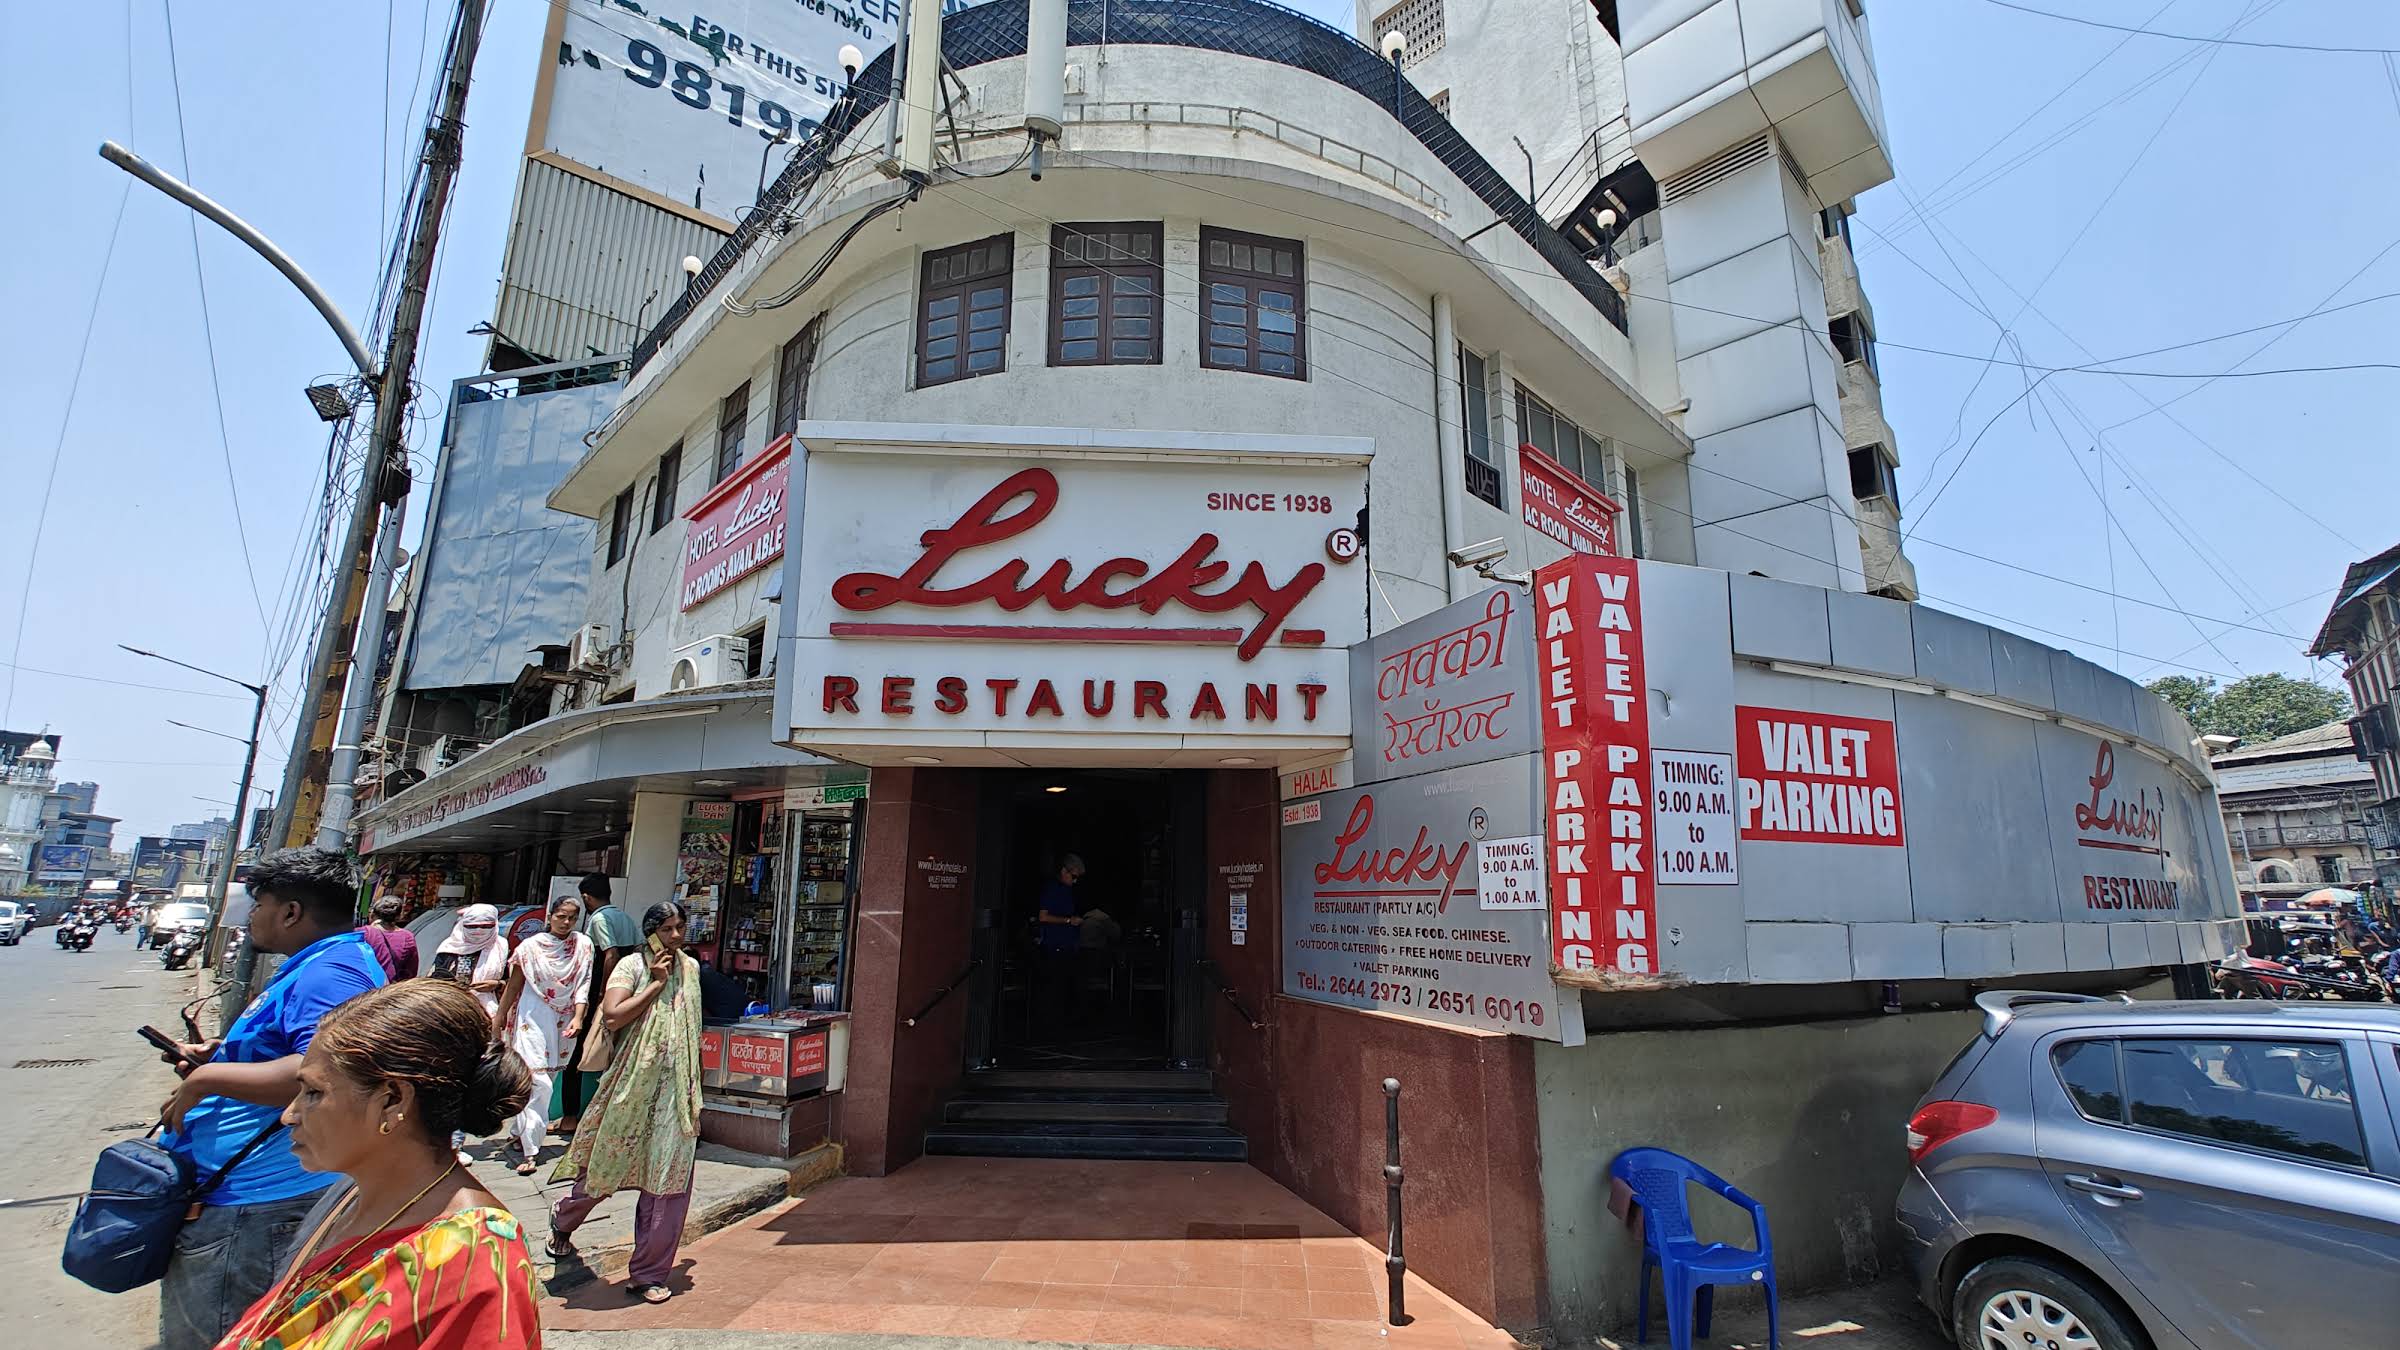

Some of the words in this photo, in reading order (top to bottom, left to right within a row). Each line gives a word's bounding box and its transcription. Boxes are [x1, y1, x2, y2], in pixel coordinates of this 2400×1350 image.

[750, 43, 808, 86] THIS
[761, 464, 779, 484] SINCE
[1207, 492, 1276, 512] SINCE
[1282, 494, 1333, 514] 1938
[1523, 470, 1561, 510] HOTEL
[1564, 497, 1610, 545] Lucky
[688, 524, 719, 565] HOTEL
[723, 484, 782, 545] Lucky
[1524, 503, 1539, 528] AC
[1540, 513, 1570, 545] ROOM
[682, 579, 697, 609] AC
[693, 560, 728, 602] ROOMS
[726, 523, 785, 579] AVAILABLE
[831, 467, 1326, 662] Lucky
[1542, 575, 1577, 727] VALET
[1595, 572, 1636, 722] VALET
[822, 676, 1327, 721] RESTAURANT
[1757, 720, 1870, 778] VALET
[1294, 767, 1337, 796] HALAL
[1661, 761, 1724, 785] TIMING:
[699, 804, 731, 817] LUCKY
[1284, 808, 1301, 823] Estd.
[1302, 804, 1319, 819] 1938
[1658, 790, 1691, 813] 9.00
[1696, 793, 1731, 815] A.M.
[1738, 777, 1897, 837] PARKING
[2075, 740, 2164, 872] Lucky
[1688, 822, 1704, 843] to
[1314, 794, 1470, 914] Lucky
[1482, 860, 1507, 873] 9.00
[1510, 858, 1539, 872] A.M.
[1485, 842, 1534, 858] TIMING:
[1553, 750, 1594, 973] PARKING
[1607, 745, 1648, 975] PARKING
[1662, 850, 1694, 873] 1.00
[1700, 851, 1734, 873] A.M.
[1485, 891, 1509, 904] 1.00
[1512, 889, 1541, 904] A.M.
[1503, 876, 1517, 887] to
[2083, 875, 2180, 911] RESTAURANT
[1314, 902, 1370, 914] RESTAURANT
[1373, 902, 1412, 917] (PARTLY
[1415, 902, 1437, 918] A/C)
[1309, 923, 1329, 934] VEG.
[1340, 924, 1359, 935] NON
[1367, 925, 1390, 938] VEG.
[1392, 926, 1413, 938] SEA
[1415, 927, 1448, 940] FOOD.
[1451, 928, 1511, 944] CHINESE.
[1300, 939, 1339, 951] OUTDOOR
[1341, 942, 1388, 955] CATERING
[1399, 946, 1426, 959] FREE
[1429, 948, 1462, 962] HOME
[1466, 950, 1532, 968] DELIVERY
[1359, 961, 1390, 974] VALET
[1392, 964, 1440, 980] PARKING
[1297, 971, 1326, 992] Tel.:
[1329, 975, 1366, 998] 2644
[1370, 981, 1412, 1006] 2973
[1428, 989, 1475, 1015] 2651
[1485, 996, 1545, 1026] 6019
